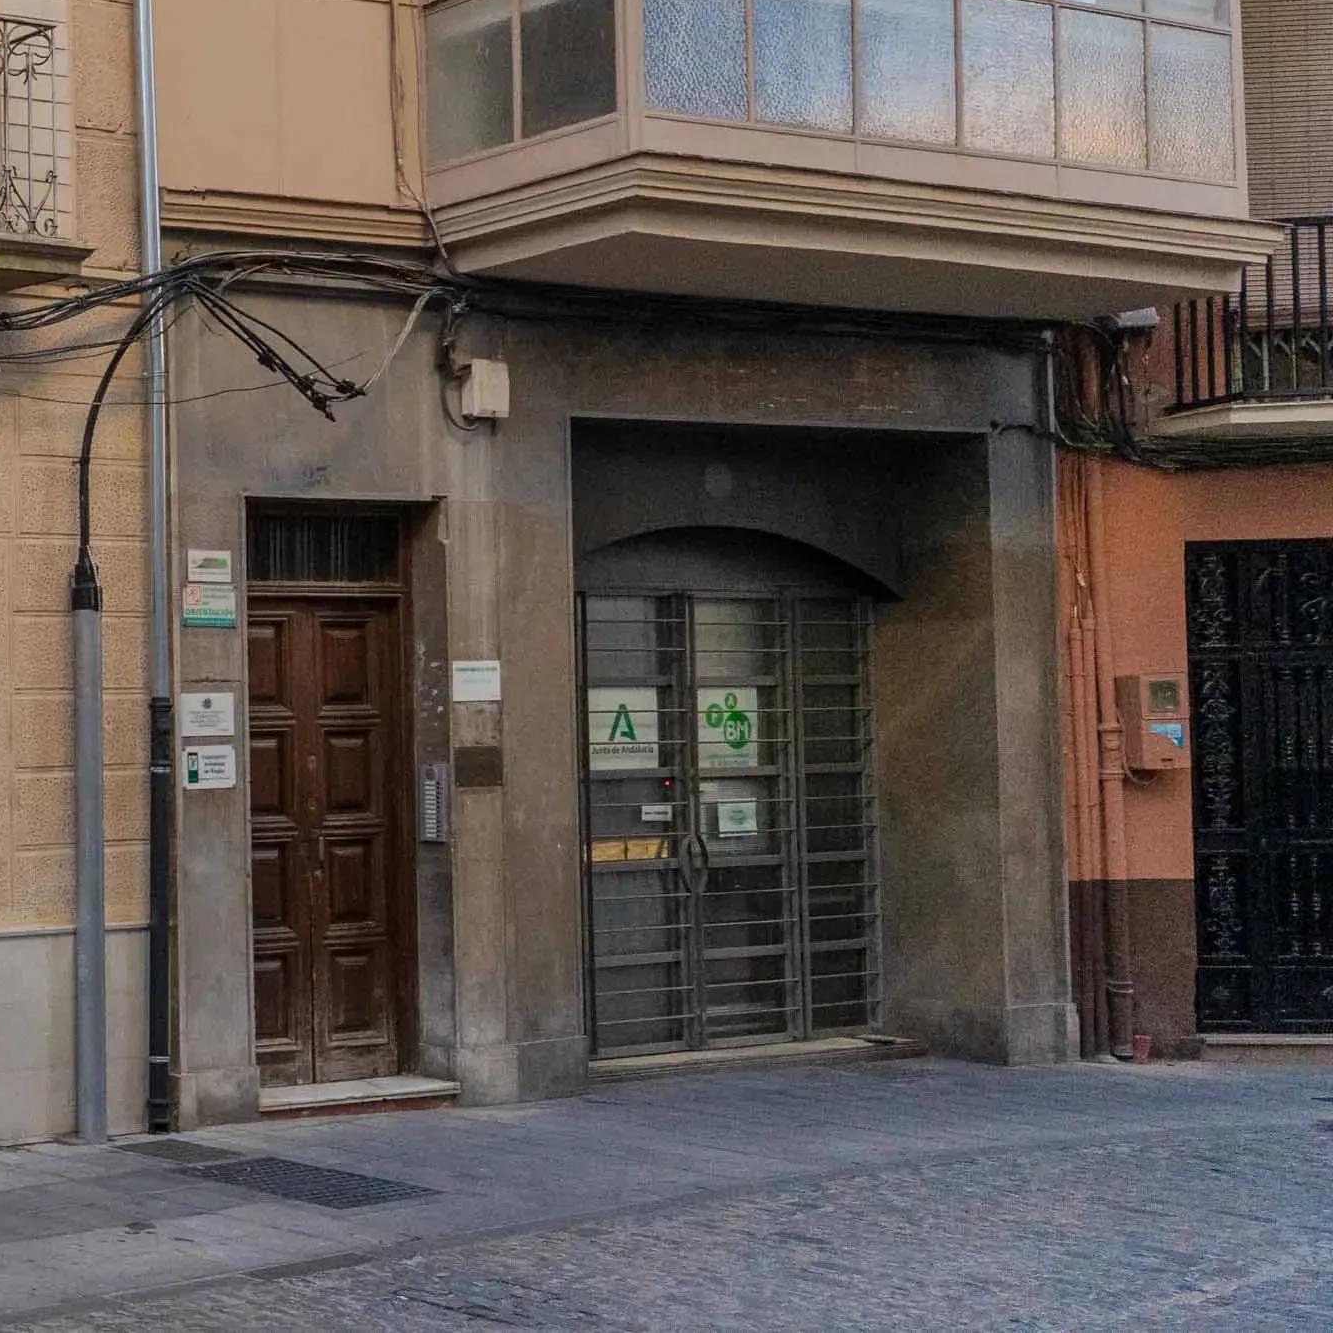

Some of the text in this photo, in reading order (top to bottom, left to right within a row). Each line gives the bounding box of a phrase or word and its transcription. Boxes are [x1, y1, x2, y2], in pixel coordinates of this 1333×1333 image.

[726, 720, 749, 740] BM
[591, 746, 610, 755] Junta
[612, 746, 620, 754] de
